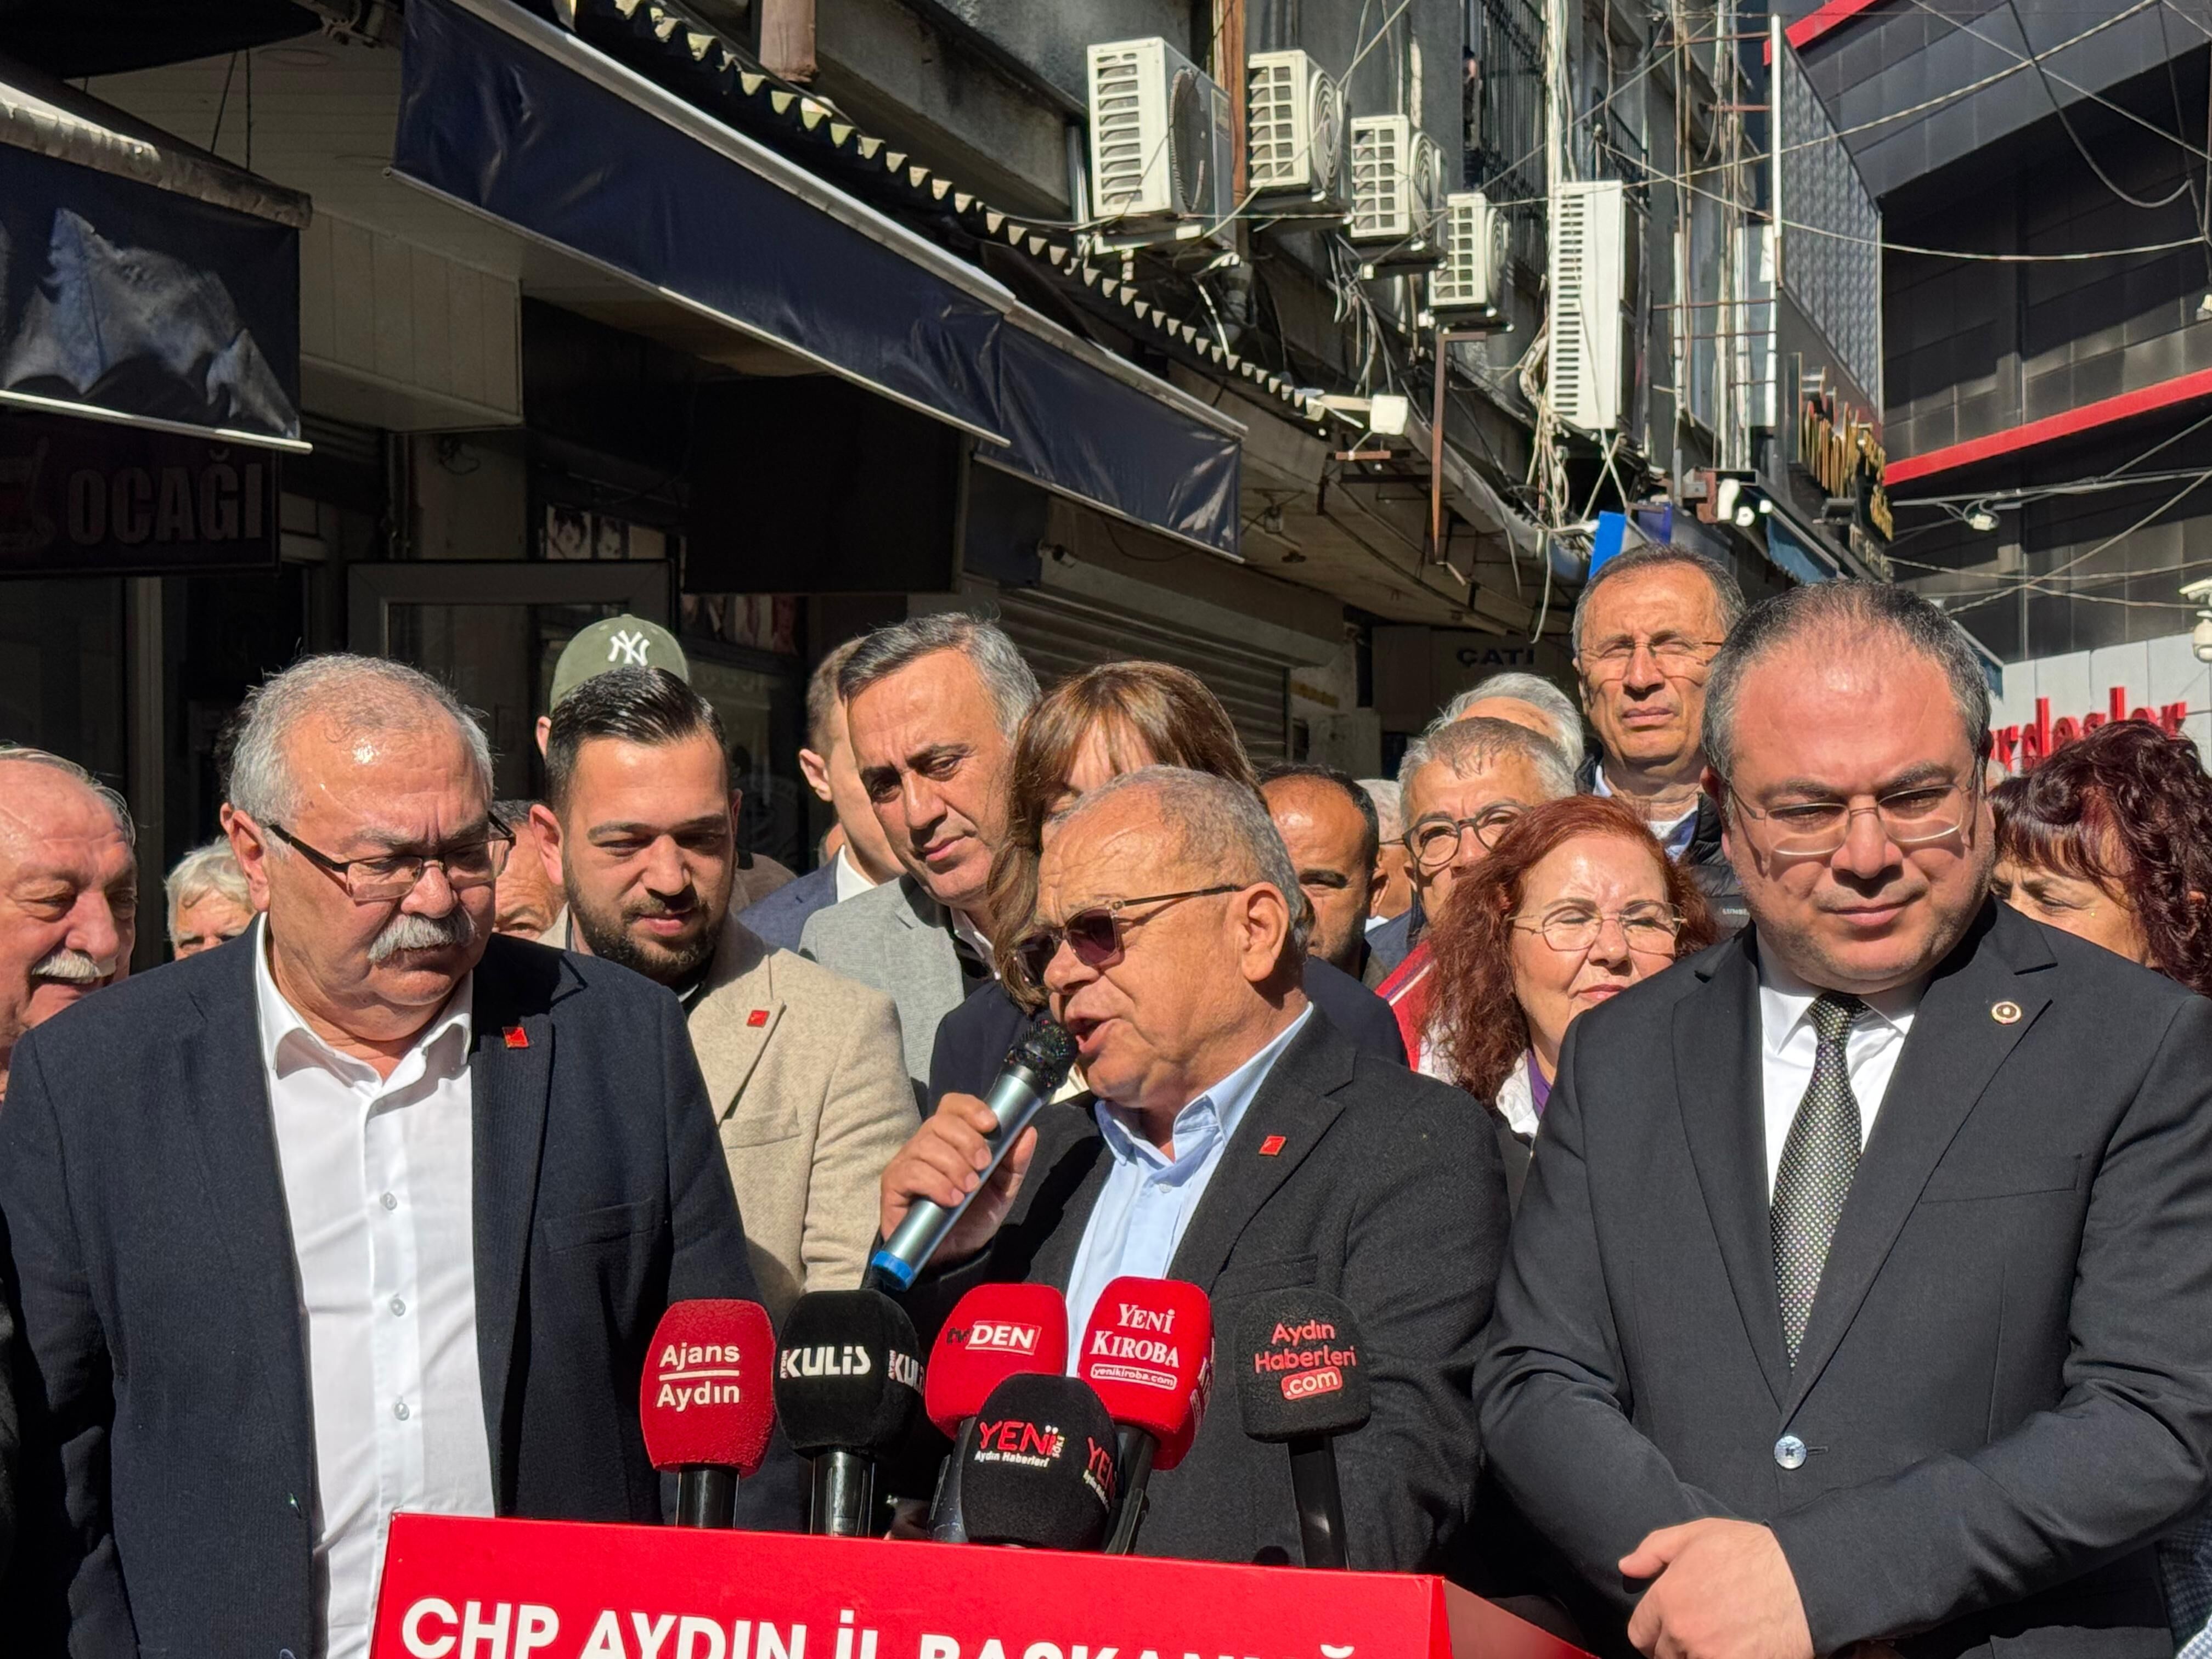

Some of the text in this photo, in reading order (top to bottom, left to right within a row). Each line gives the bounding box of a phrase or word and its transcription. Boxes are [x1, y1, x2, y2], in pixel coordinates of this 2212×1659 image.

[68, 448, 263, 545] OCAĞI
[1456, 648, 1534, 668] ÇATI
[1271, 1319, 1335, 1347] Aydın
[659, 1342, 740, 1371] Ajans
[1089, 1330, 1180, 1368] KIROBA
[1255, 1344, 1357, 1374] Haberleri
[657, 1381, 740, 1412] Aydın
[1002, 1452, 1051, 1468] Haberleri
[402, 1598, 560, 1659] CHP
[578, 1609, 808, 1659] AYDIN
